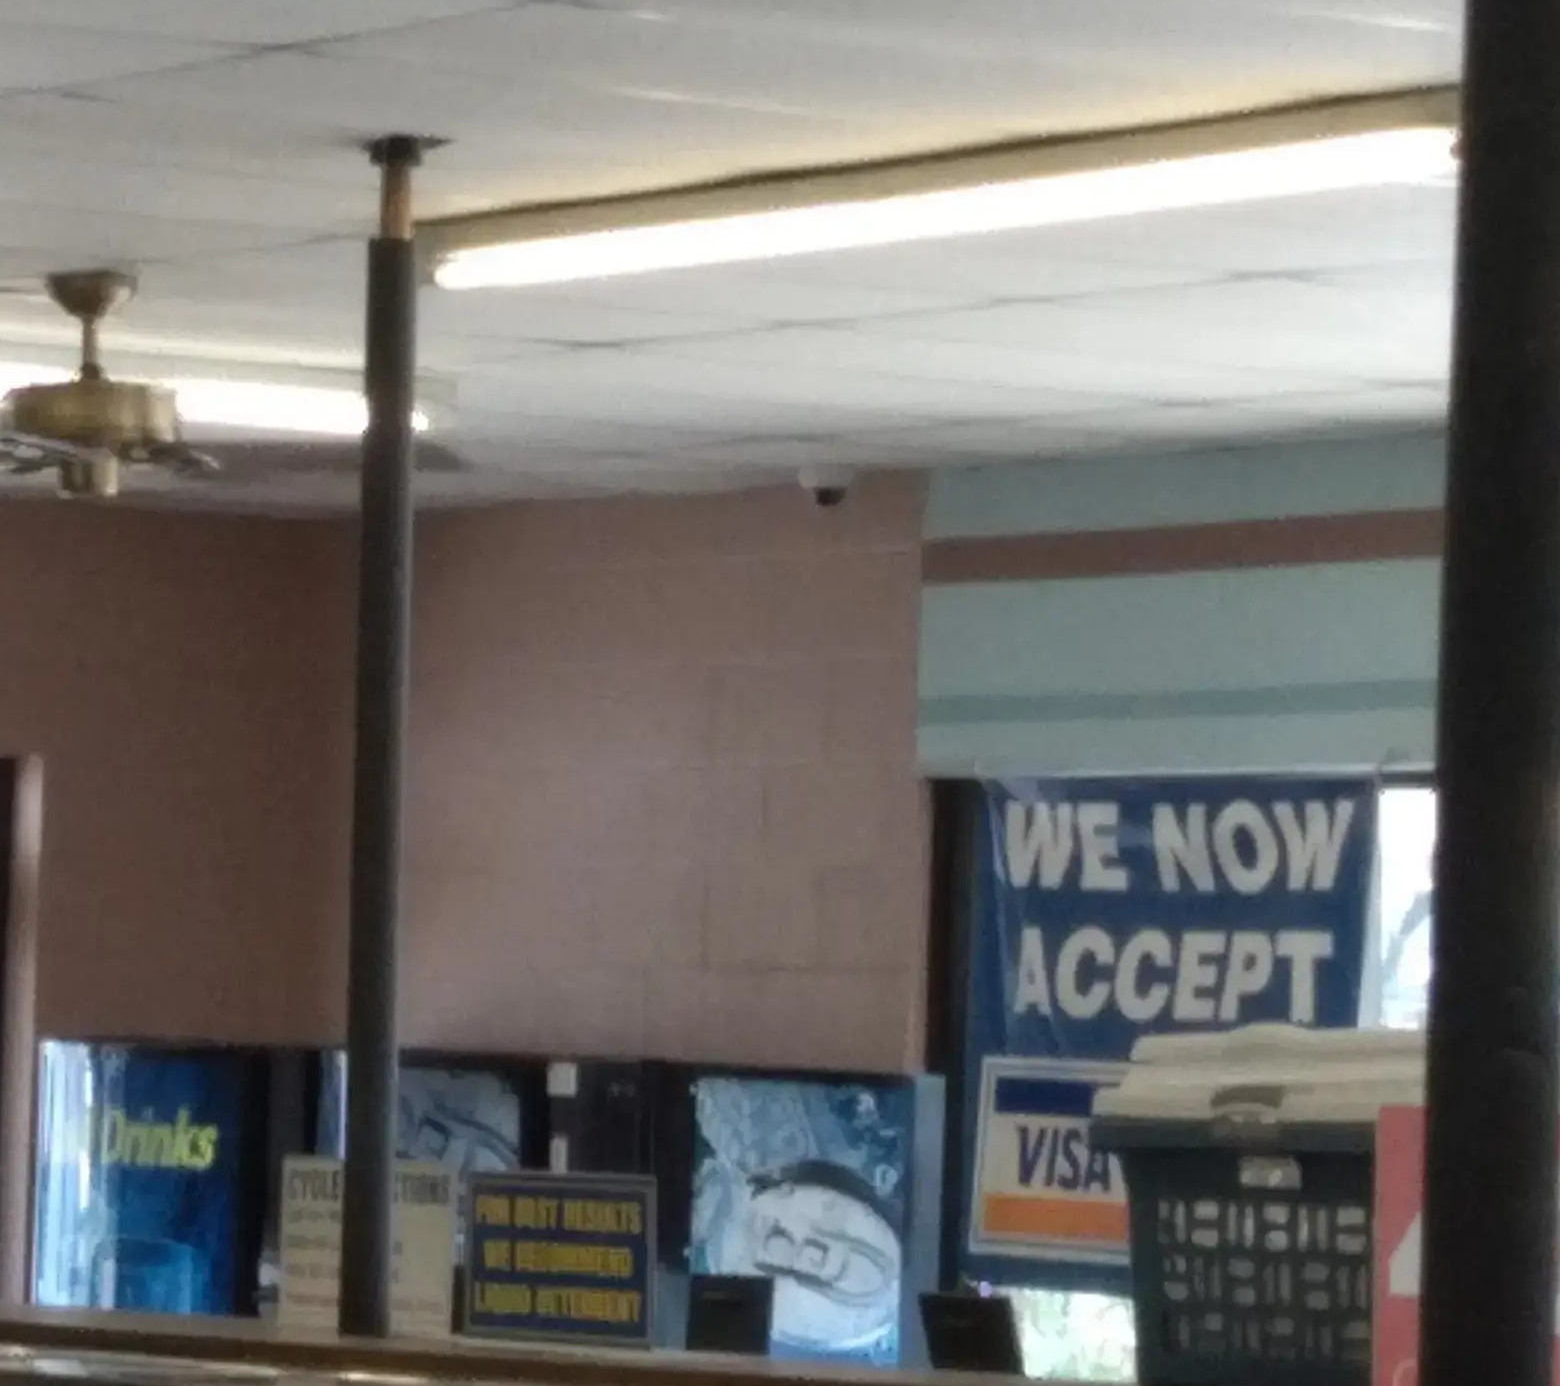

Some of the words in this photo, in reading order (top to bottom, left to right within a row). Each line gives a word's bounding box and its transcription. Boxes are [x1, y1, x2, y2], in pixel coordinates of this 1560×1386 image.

[1005, 800, 1129, 892] WE
[1152, 799, 1354, 895] NOW
[1013, 924, 1334, 1024] ACCEPT
[101, 1106, 217, 1170] Drinks
[1015, 1125, 1112, 1193] VISA
